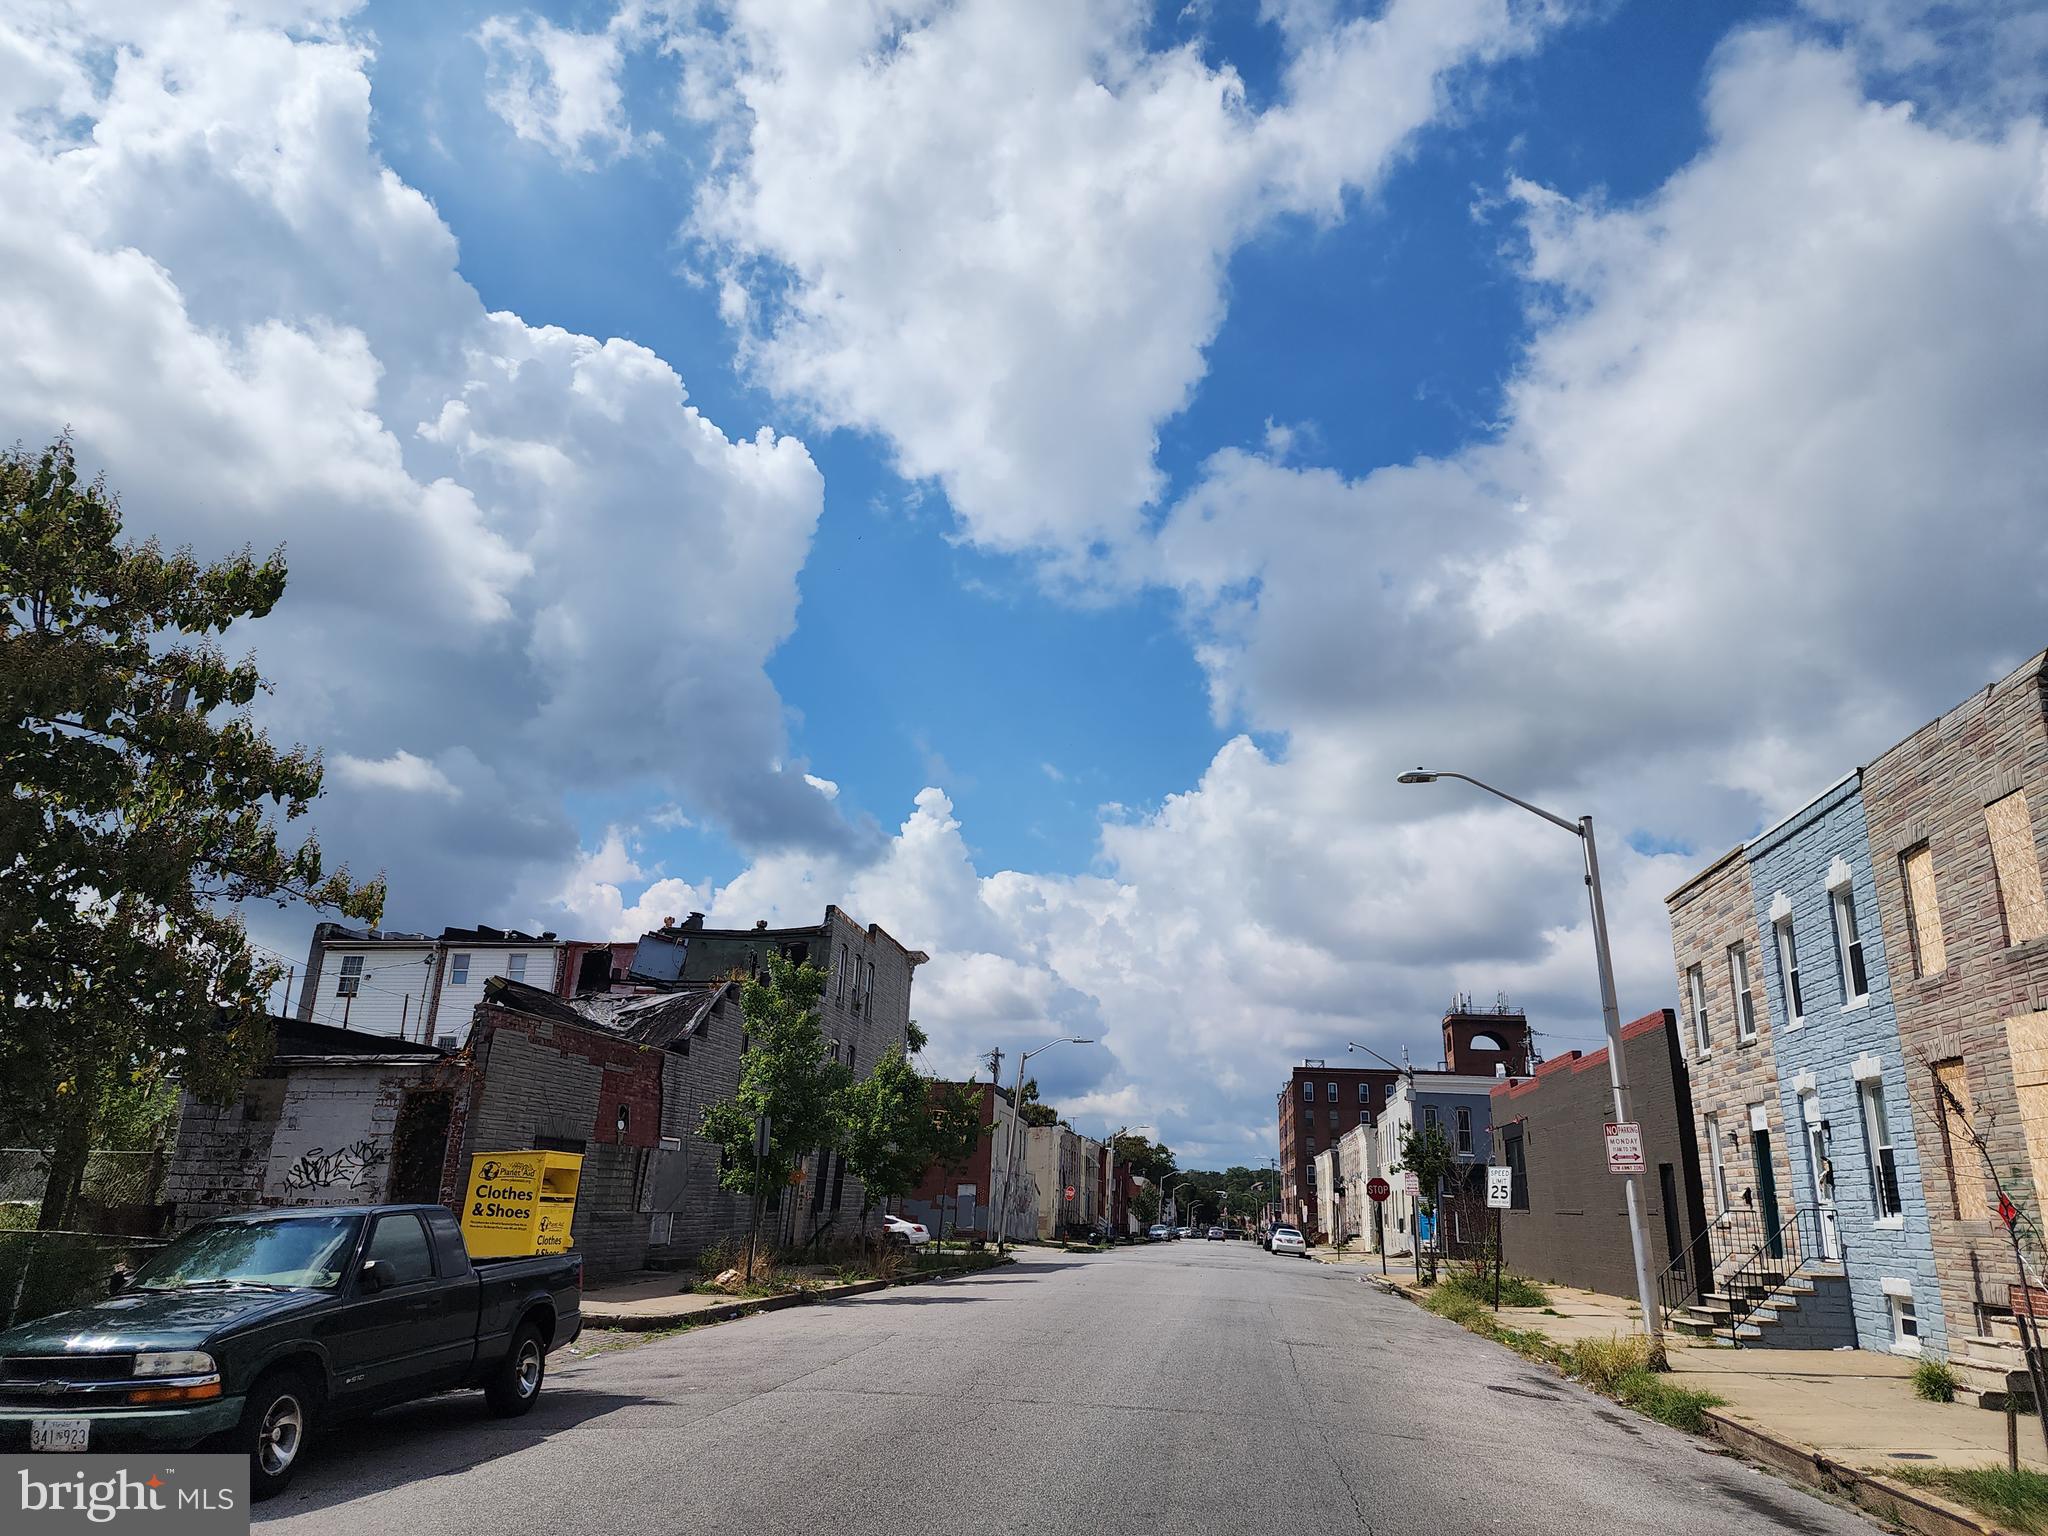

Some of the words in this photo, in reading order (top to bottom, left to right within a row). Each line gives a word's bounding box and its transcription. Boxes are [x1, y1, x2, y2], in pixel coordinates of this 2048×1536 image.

[1606, 1126, 1618, 1135] NO
[1618, 1126, 1638, 1134] PARKING
[500, 1168, 521, 1176] Planet
[523, 1168, 536, 1178] Aid
[476, 1184, 533, 1201] Clothes
[1368, 1185, 1388, 1195] STOP
[1491, 1185, 1508, 1200] 25
[472, 1202, 484, 1216] &
[486, 1203, 530, 1219] Shoes
[537, 1235, 562, 1246] Clothes
[33, 1430, 53, 1445] 341
[64, 1429, 86, 1444] 923
